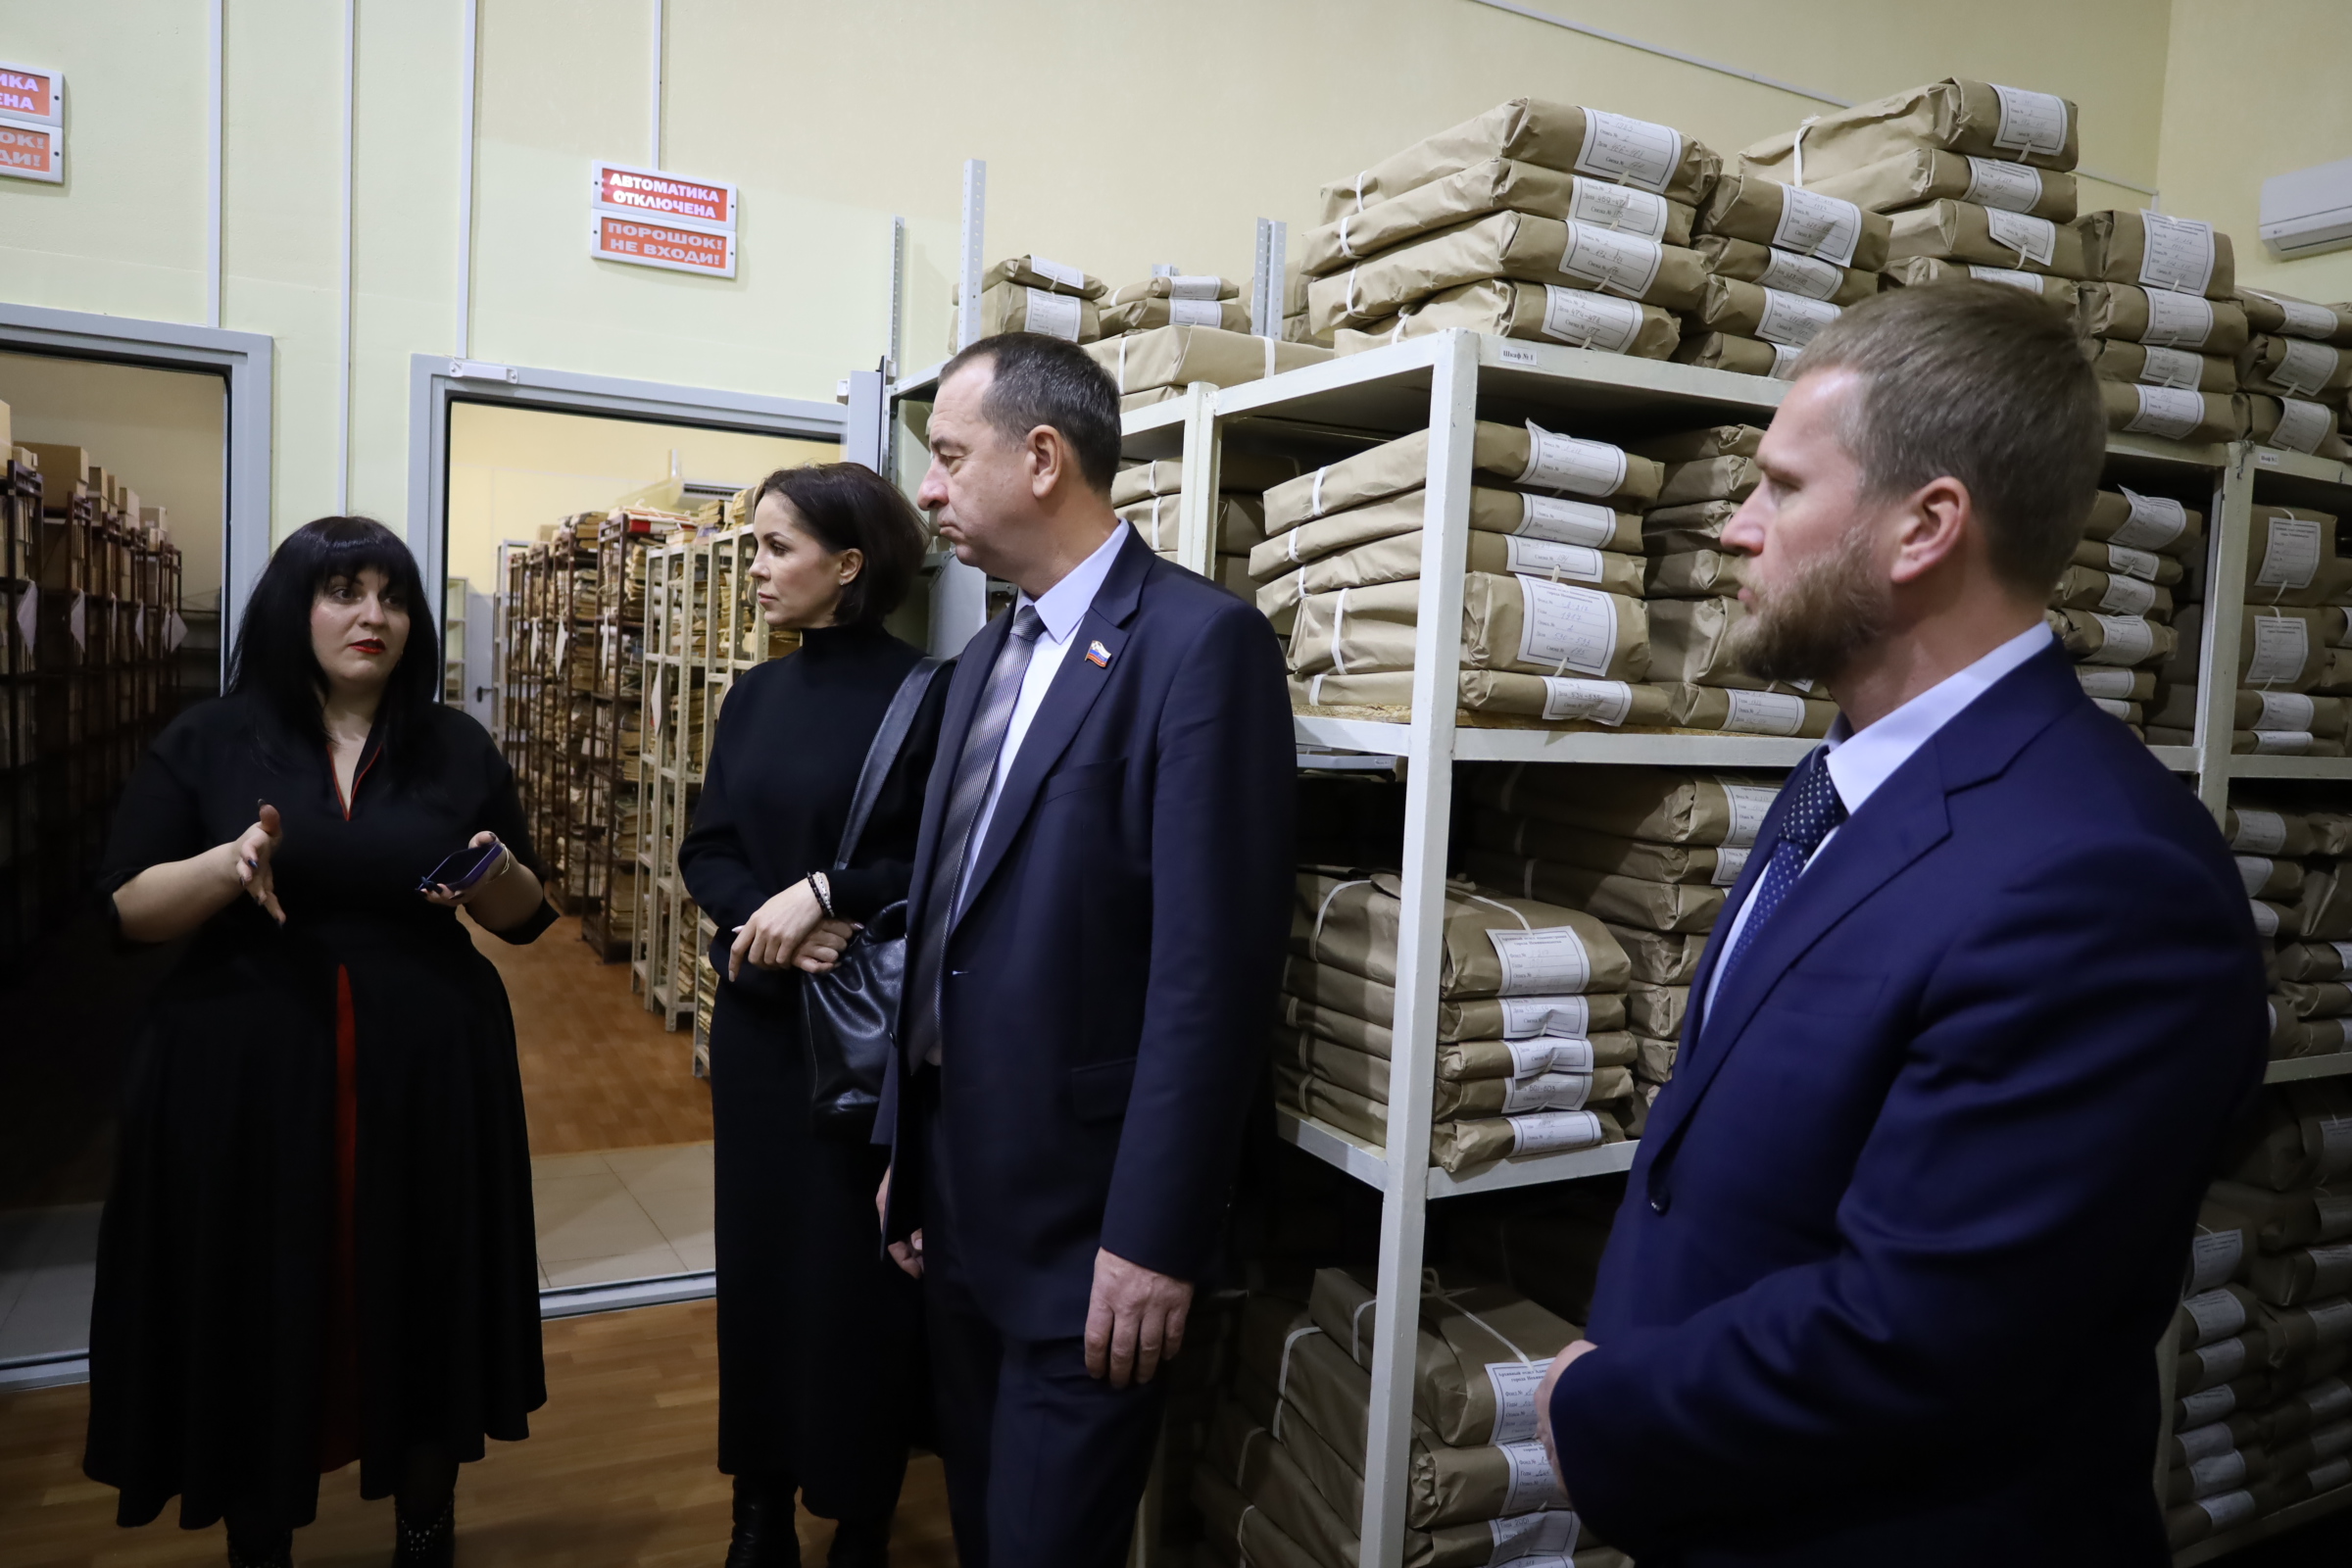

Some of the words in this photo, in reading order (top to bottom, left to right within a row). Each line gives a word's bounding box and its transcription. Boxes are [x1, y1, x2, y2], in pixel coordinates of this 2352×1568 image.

[0, 92, 35, 111] НА
[610, 173, 719, 203] АВТОМАТИКА
[613, 190, 716, 218] ОТКЛЮЧЕНА
[608, 222, 722, 250] ПОРОШОК!
[611, 239, 638, 253] НЕ
[643, 244, 720, 266] ВХОДИ!
[1503, 350, 1522, 361] Шкаф
